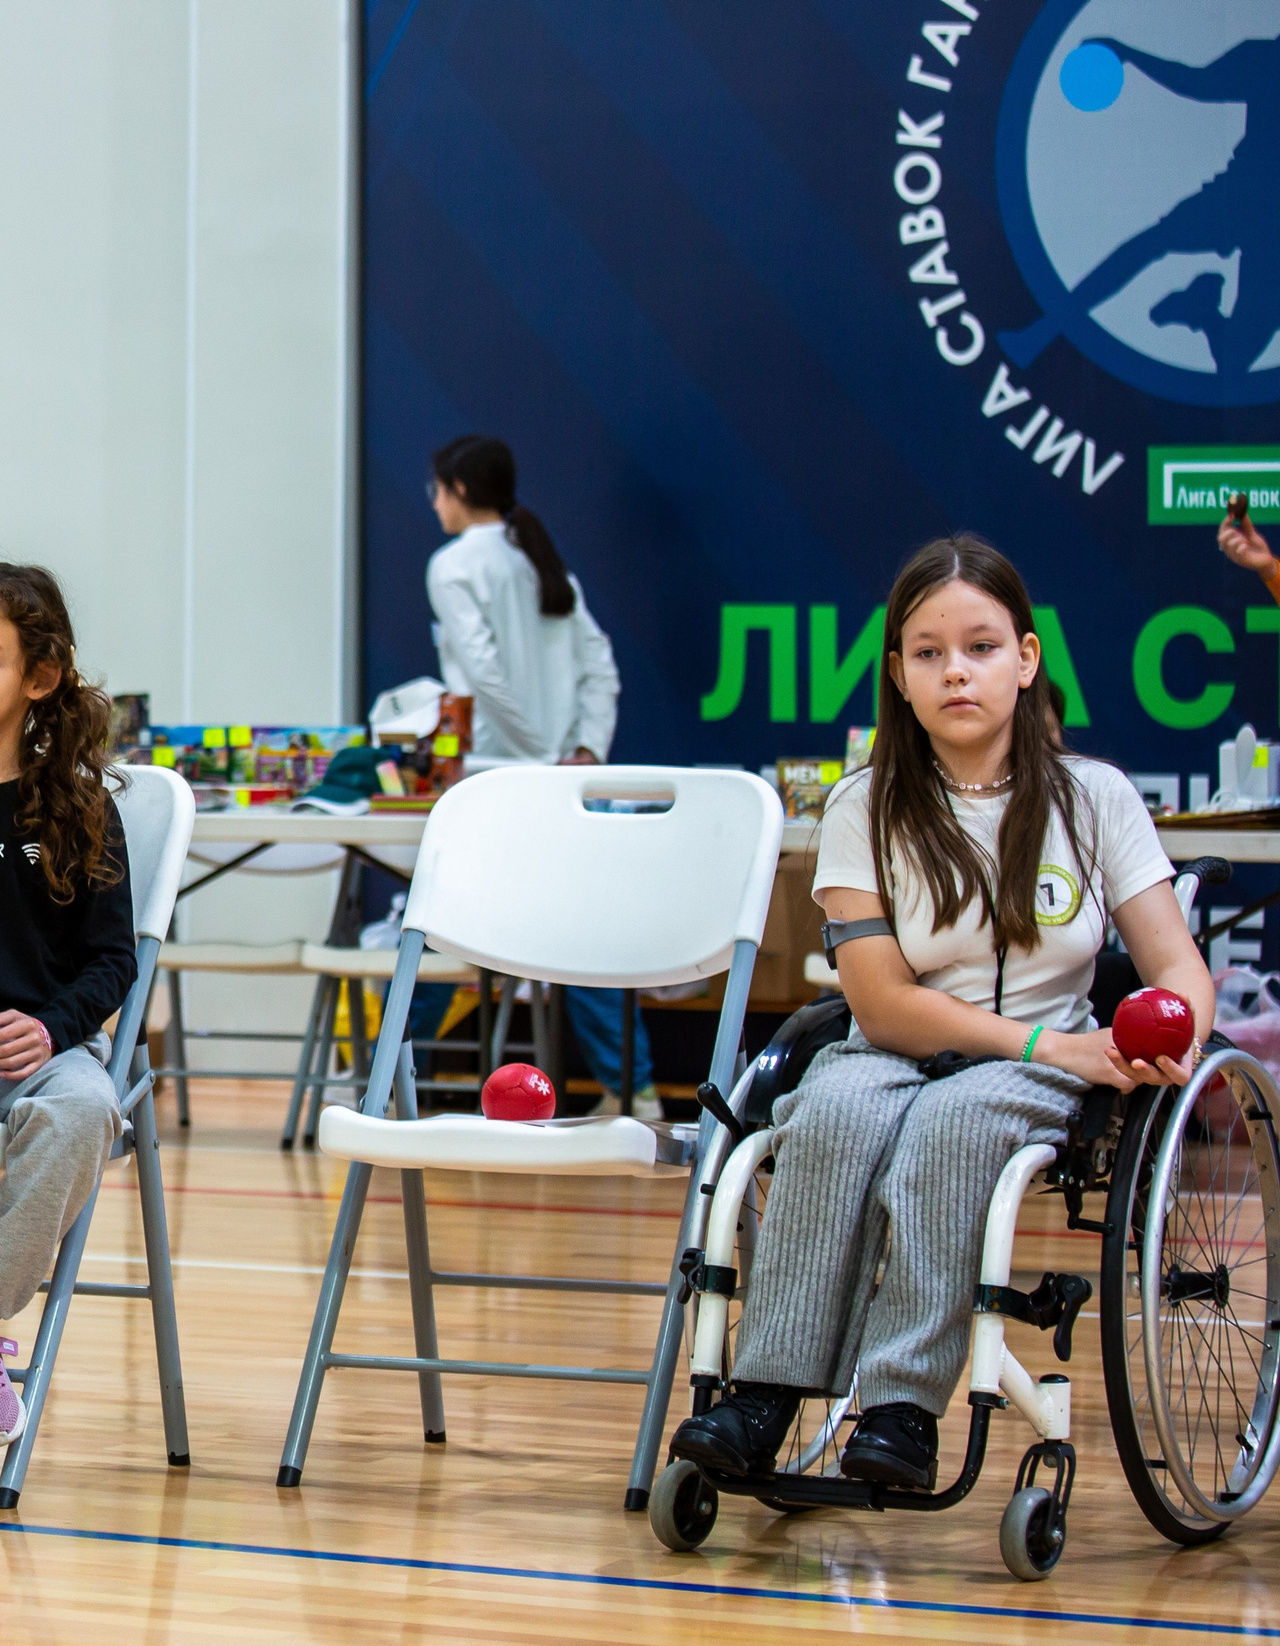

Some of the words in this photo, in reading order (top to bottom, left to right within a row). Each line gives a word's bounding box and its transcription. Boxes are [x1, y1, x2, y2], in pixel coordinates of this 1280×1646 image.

[893, 108, 986, 366] СТАВОК
[981, 361, 1125, 496] ЛИГА
[1039, 883, 1055, 906] 1
